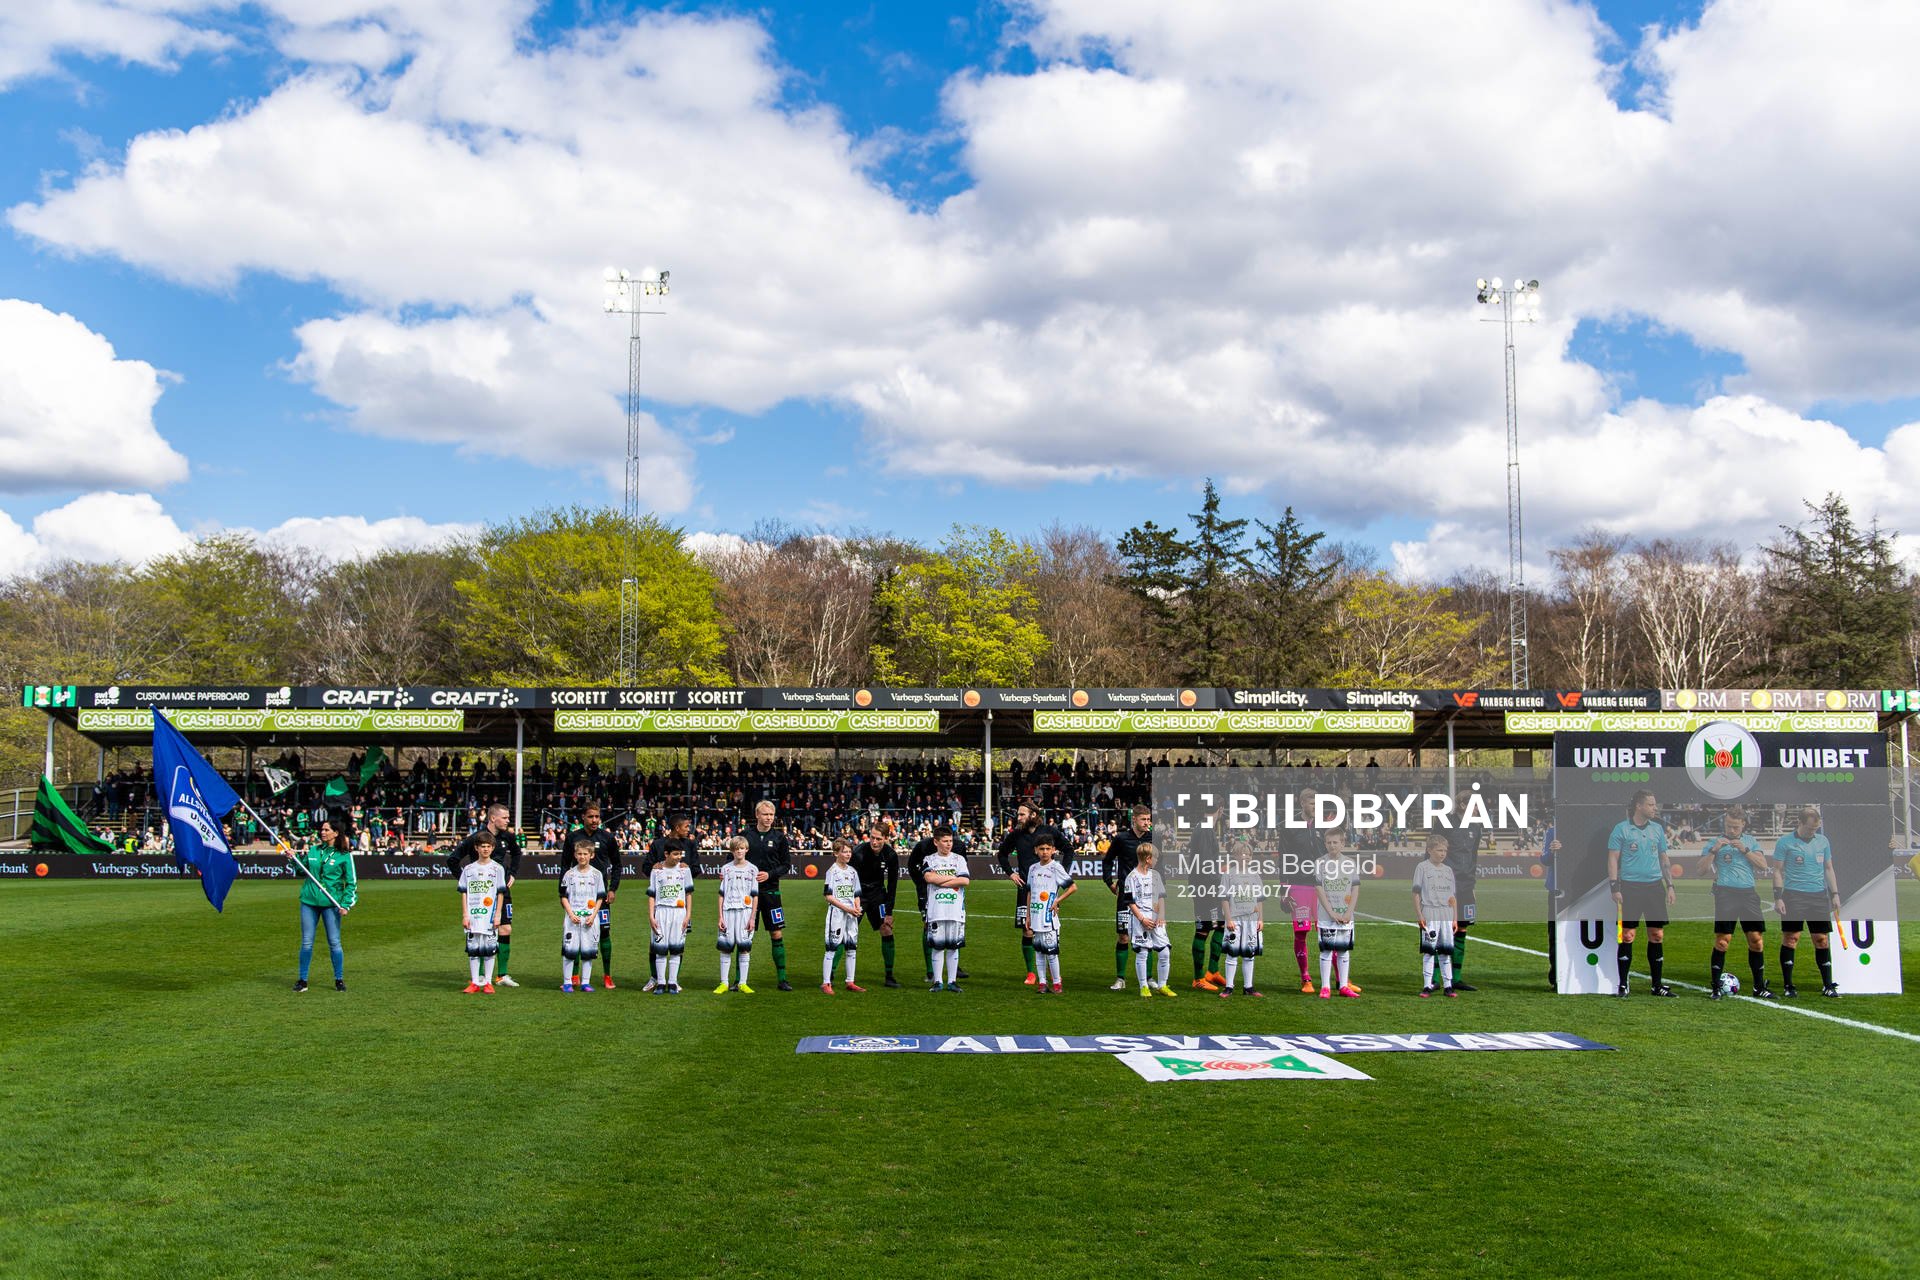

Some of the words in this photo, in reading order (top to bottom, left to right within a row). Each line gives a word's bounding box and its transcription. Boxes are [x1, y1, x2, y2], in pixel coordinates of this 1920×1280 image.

[95, 698, 120, 706] paper
[136, 692, 170, 701] CUSTOM
[171, 692, 195, 701] MADE
[197, 692, 250, 701] PAPERBOARD
[265, 698, 291, 706] paper
[323, 690, 395, 705] CRAFT
[431, 691, 501, 705] CRAFT
[551, 691, 607, 704] SCORETT
[620, 691, 675, 704] SCORETT
[688, 691, 743, 704] SCORETT
[782, 693, 815, 703] Varbergs
[816, 693, 850, 703] Sparbank
[891, 693, 923, 703] Varbergs
[924, 693, 958, 703] Sparbank
[1000, 693, 1032, 703] Varbergs
[1033, 693, 1067, 703] Sparbank
[1108, 693, 1139, 703] Varbergs
[1140, 693, 1175, 703] Sparbank
[1234, 690, 1308, 707] Simplicity.
[1346, 691, 1420, 708] Simplicity.
[1480, 697, 1513, 707] VARBERG
[1516, 697, 1544, 707] ENERGI
[1583, 697, 1615, 707] VARBERG
[1619, 697, 1647, 707] ENERGI
[81, 714, 154, 727] CASHBUDD
[179, 714, 262, 727] CASHBUDDY
[277, 714, 362, 727] CASHBUDDY
[375, 715, 459, 728] CASHBUDDY
[558, 715, 642, 728] CASHBUDDY
[656, 715, 740, 728] CASHBUDDY
[754, 715, 837, 728] CASHBUDDY
[852, 715, 935, 728] CASHBUDDY
[1036, 715, 1121, 728] CASHBUDDY
[1134, 715, 1217, 728] CASHBUDDY
[1231, 715, 1314, 728] CASHBUDDY
[1327, 715, 1408, 728] CASHBUDDY
[1509, 716, 1591, 729] CASHBUDDY
[1603, 716, 1686, 729] CASHBUDDY
[1700, 717, 1780, 730] BUDDY
[1795, 717, 1875, 730] CASHBUDDY
[710, 735, 718, 744] K
[1197, 736, 1204, 745] L
[1574, 748, 1666, 768] UNIBET
[1779, 748, 1869, 769] UNIBET
[92, 863, 138, 877] Varbergs
[141, 863, 191, 877] Sparbak
[238, 863, 283, 877] Varbergs
[384, 863, 430, 877] Varbergs
[1475, 864, 1523, 877] Sparbank
[935, 893, 957, 903] coop
[1580, 918, 1603, 949] U
[1851, 918, 1874, 949] U
[936, 1032, 1583, 1053] ALLSVENSKAN
